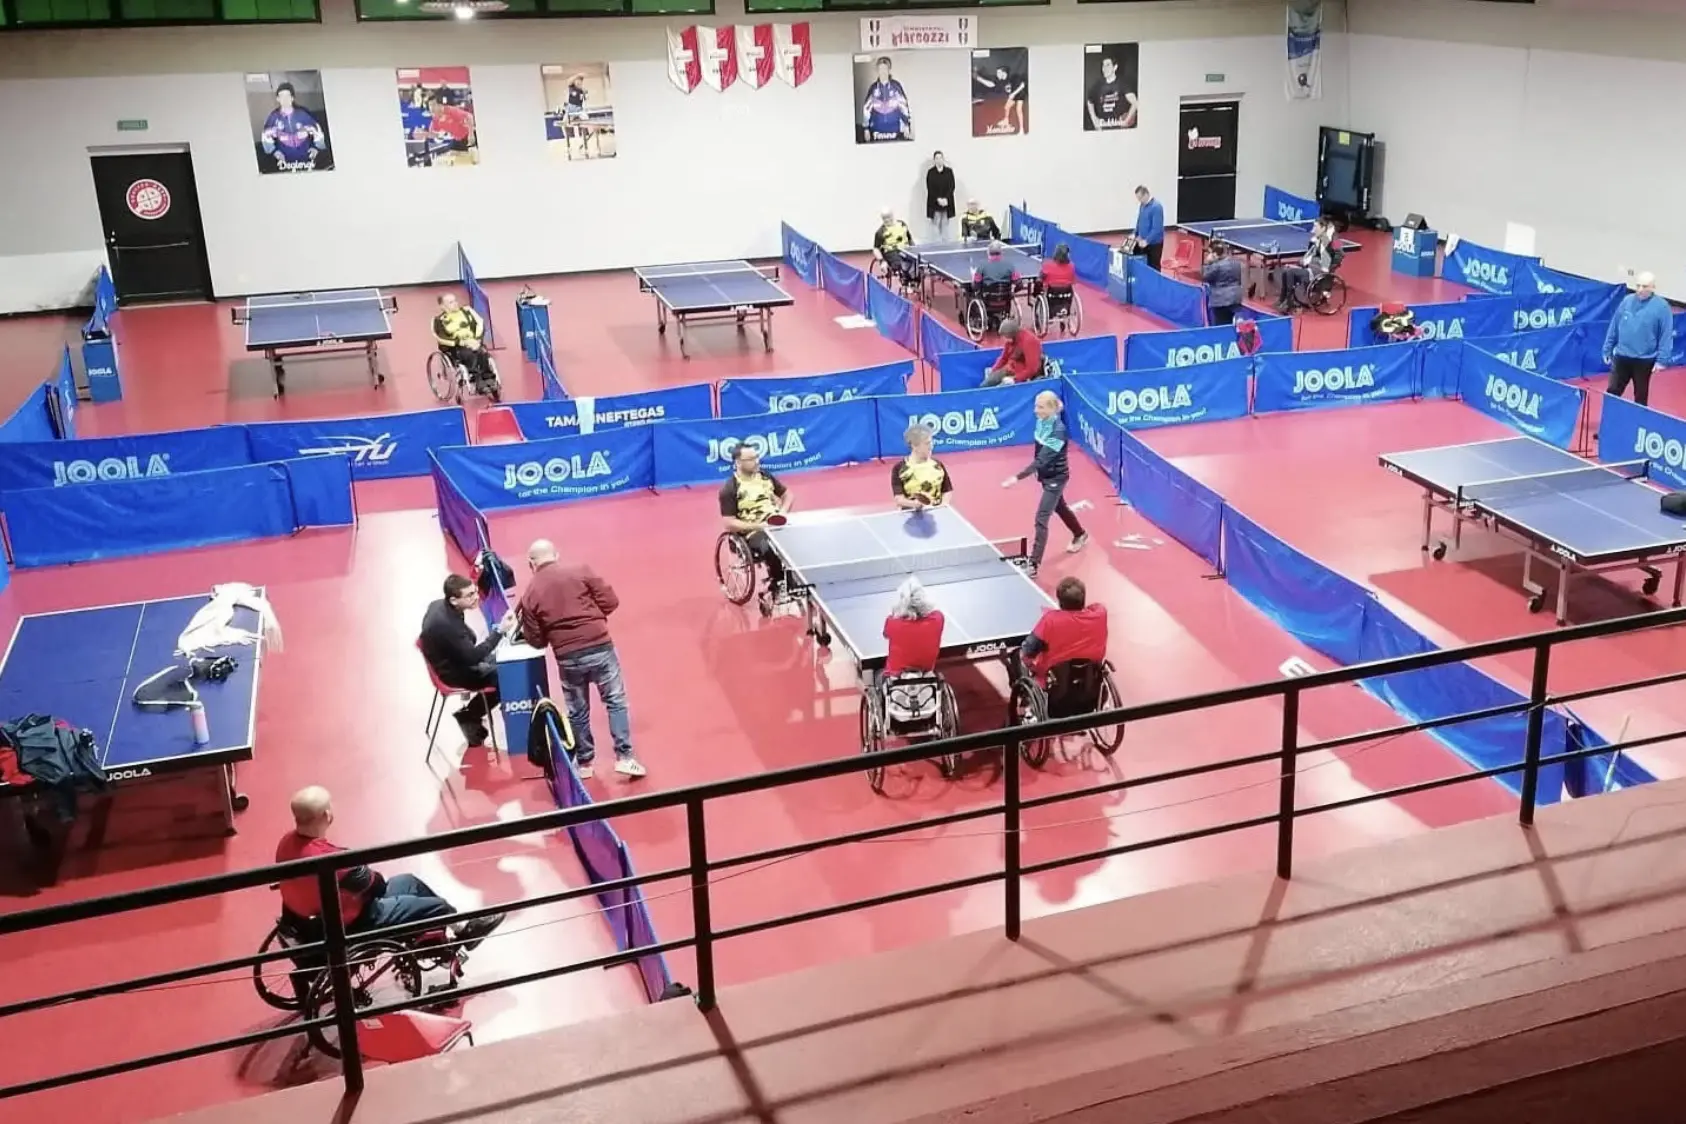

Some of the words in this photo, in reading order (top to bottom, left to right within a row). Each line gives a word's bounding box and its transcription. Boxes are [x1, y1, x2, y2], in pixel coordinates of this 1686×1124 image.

[1463, 258, 1508, 285] JOOLA
[1420, 318, 1463, 340] OLA
[1166, 341, 1241, 368] JOOLA
[1293, 364, 1375, 394] JOOLA
[1106, 383, 1192, 415] JOOLA
[1485, 374, 1540, 419] JOOLA
[706, 428, 806, 464] JOOLA
[945, 437, 988, 447] Champion
[1634, 426, 1686, 471] JOO
[54, 453, 170, 488] JOOLA
[504, 450, 612, 489] JOOLA
[533, 487, 548, 495] the
[550, 484, 598, 495] Champion
[600, 483, 610, 491] in
[975, 641, 1007, 653] JOOLA
[505, 699, 533, 712] JOOL
[106, 767, 152, 782] JOOLA
